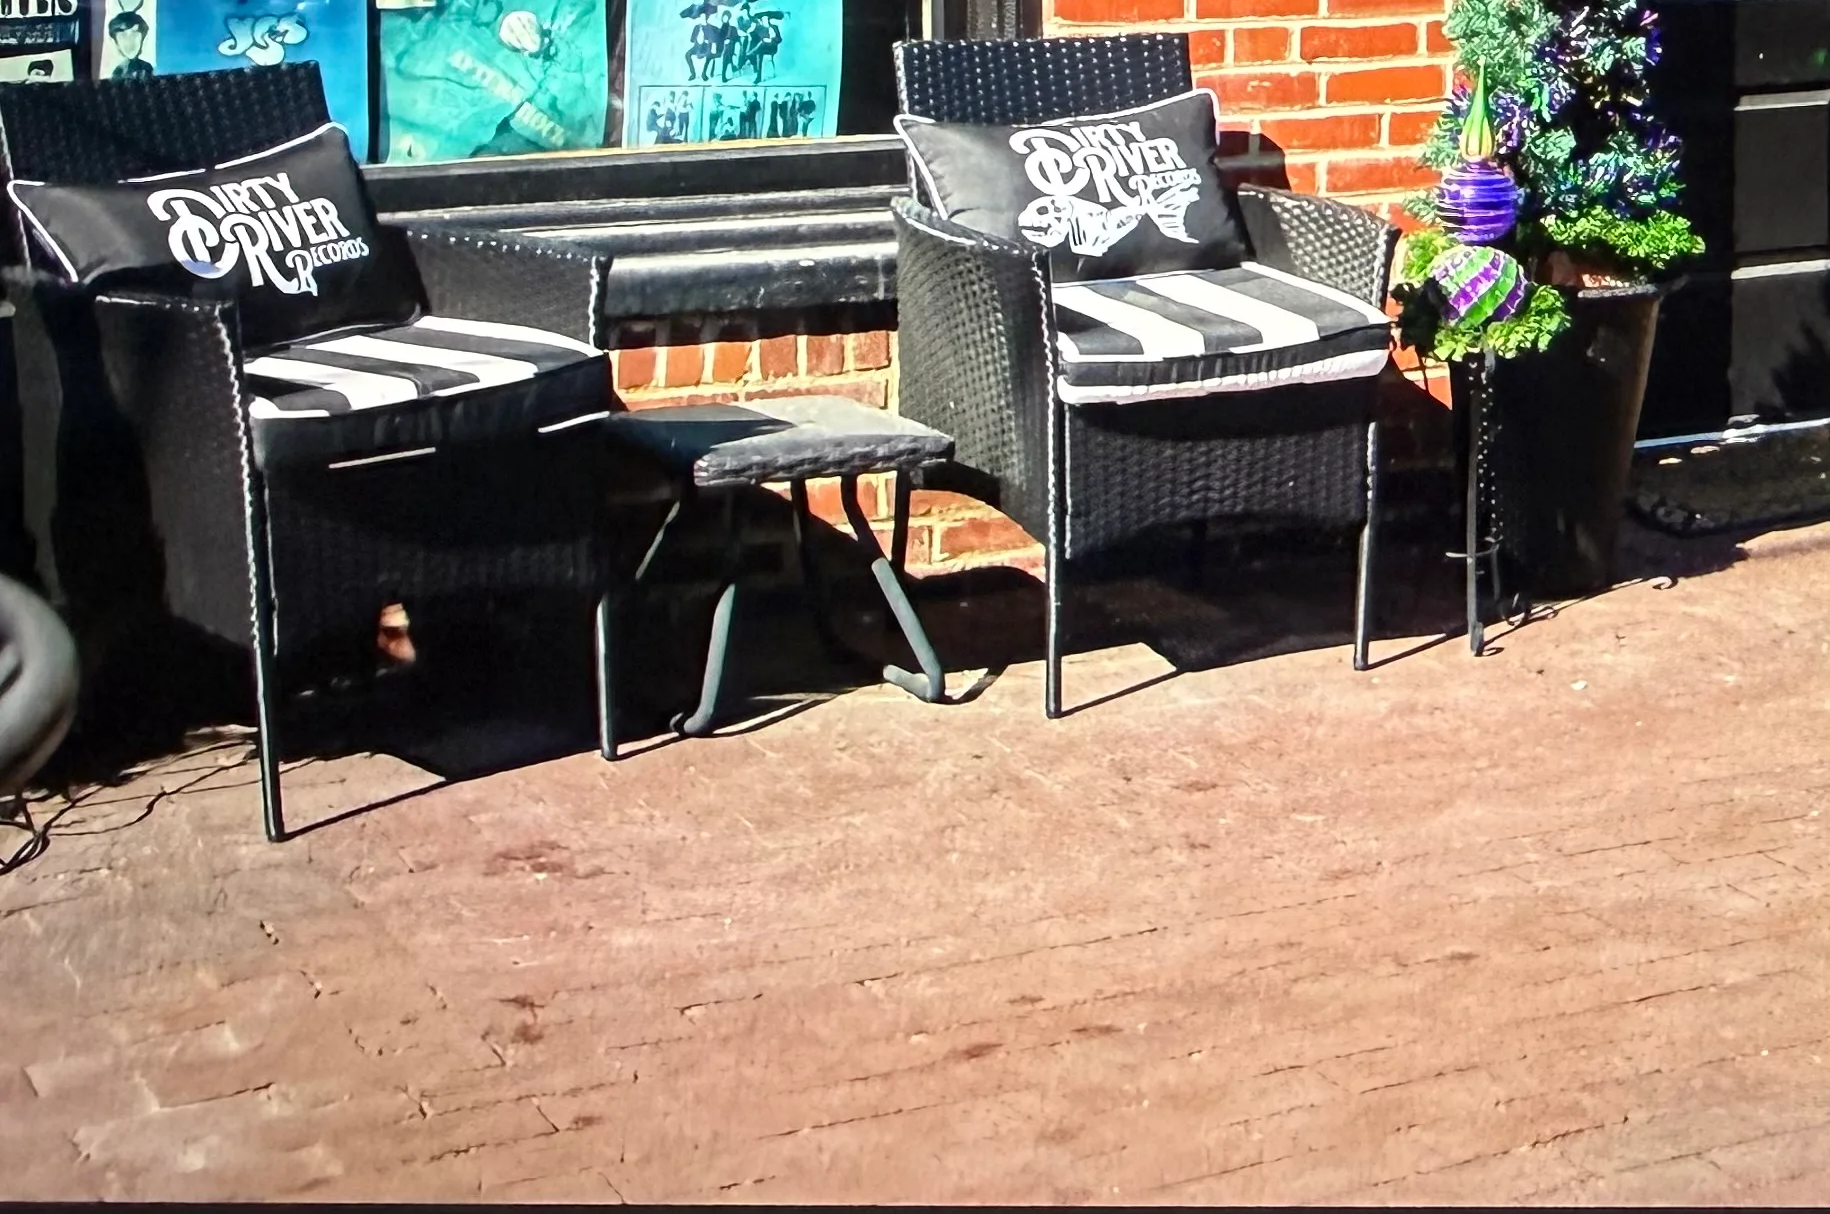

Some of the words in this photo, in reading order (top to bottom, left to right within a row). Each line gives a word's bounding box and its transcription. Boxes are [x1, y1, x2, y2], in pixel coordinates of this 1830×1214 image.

[1072, 137, 1187, 208] RIVER
[147, 172, 300, 280] DIRTY
[219, 198, 351, 296] RIVER
[285, 236, 371, 297] RECORDS
